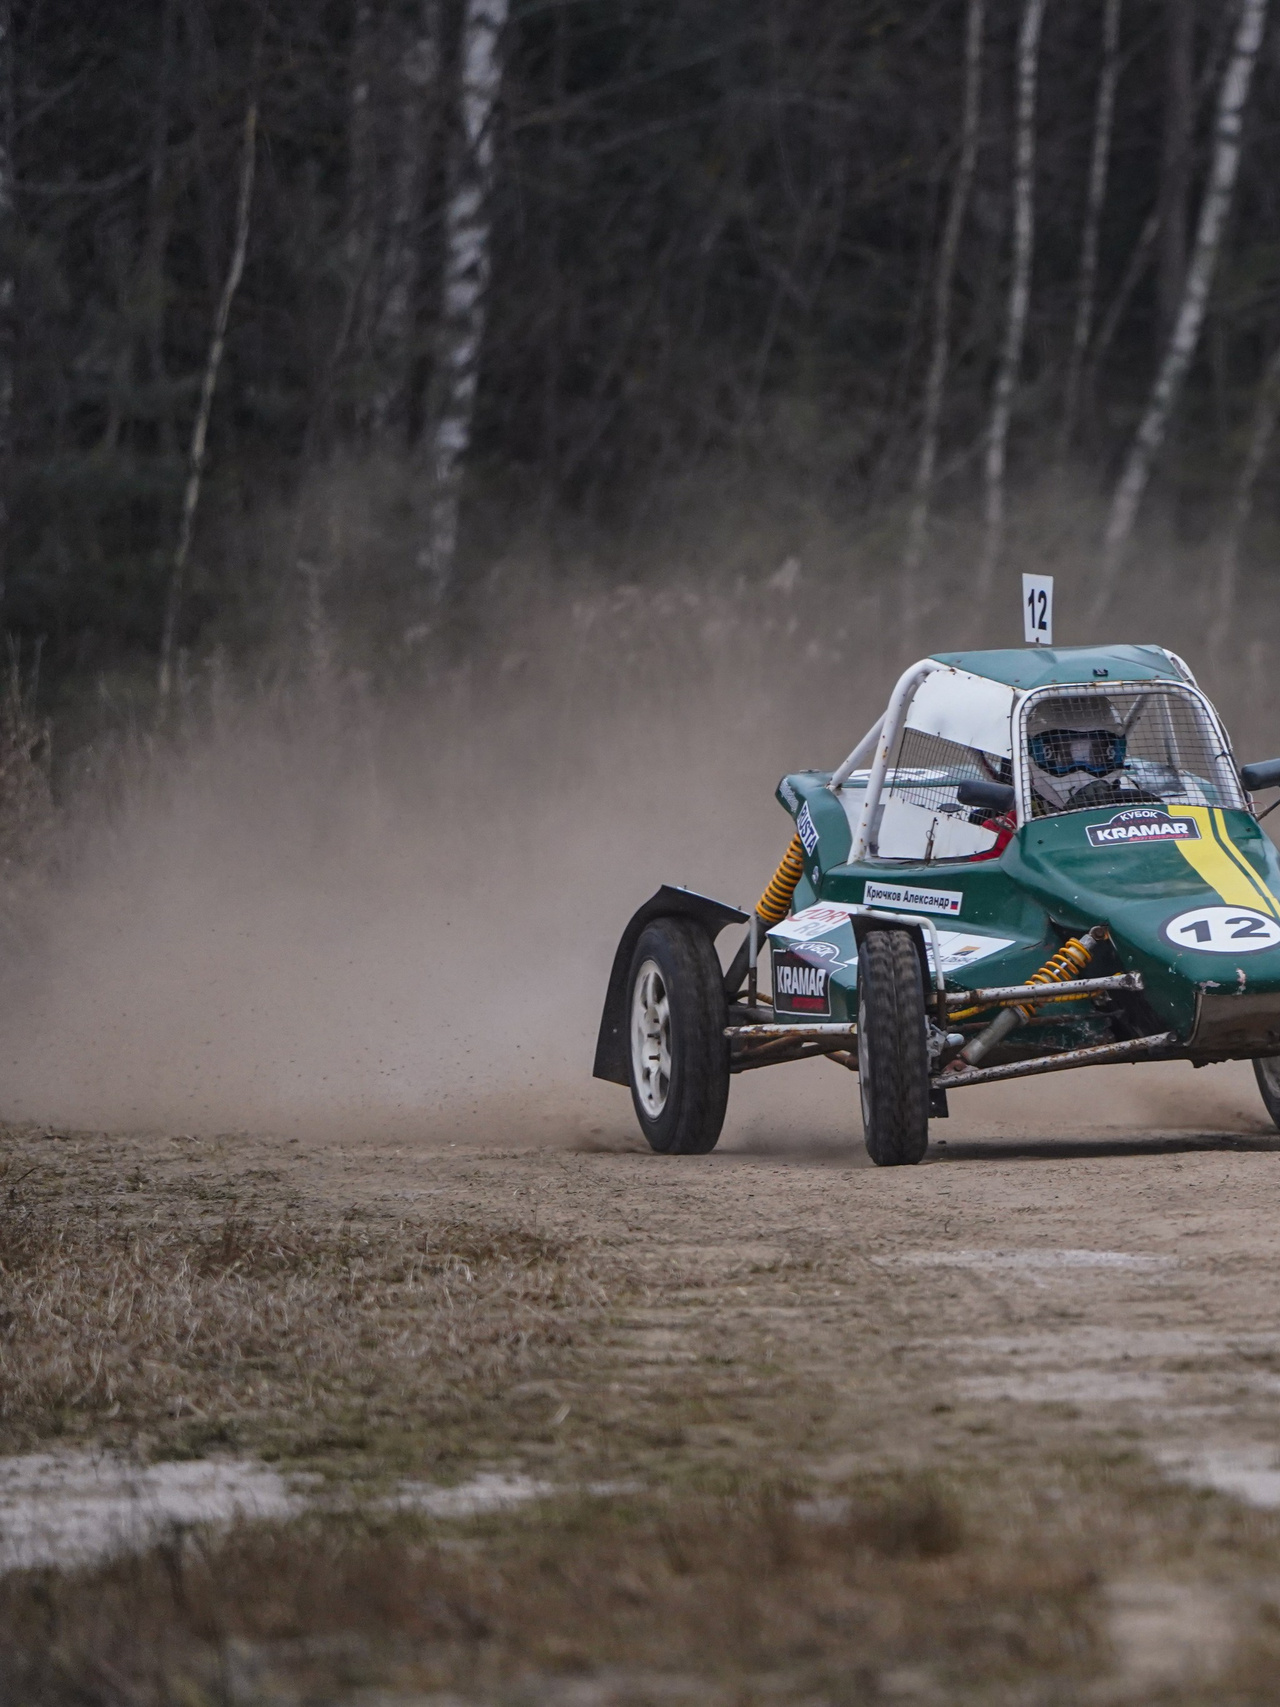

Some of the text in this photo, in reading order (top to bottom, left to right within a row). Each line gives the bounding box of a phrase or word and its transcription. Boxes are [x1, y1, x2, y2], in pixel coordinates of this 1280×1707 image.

[1028, 589, 1047, 630] 12
[1120, 810, 1158, 821] КУБОК
[798, 804, 818, 854] RUSTA
[1096, 822, 1189, 841] KRAMAR
[866, 885, 950, 909] Крючков Александр
[1180, 916, 1271, 943] 12
[796, 943, 834, 958] КУБОК
[776, 965, 827, 997] KRAMAR
